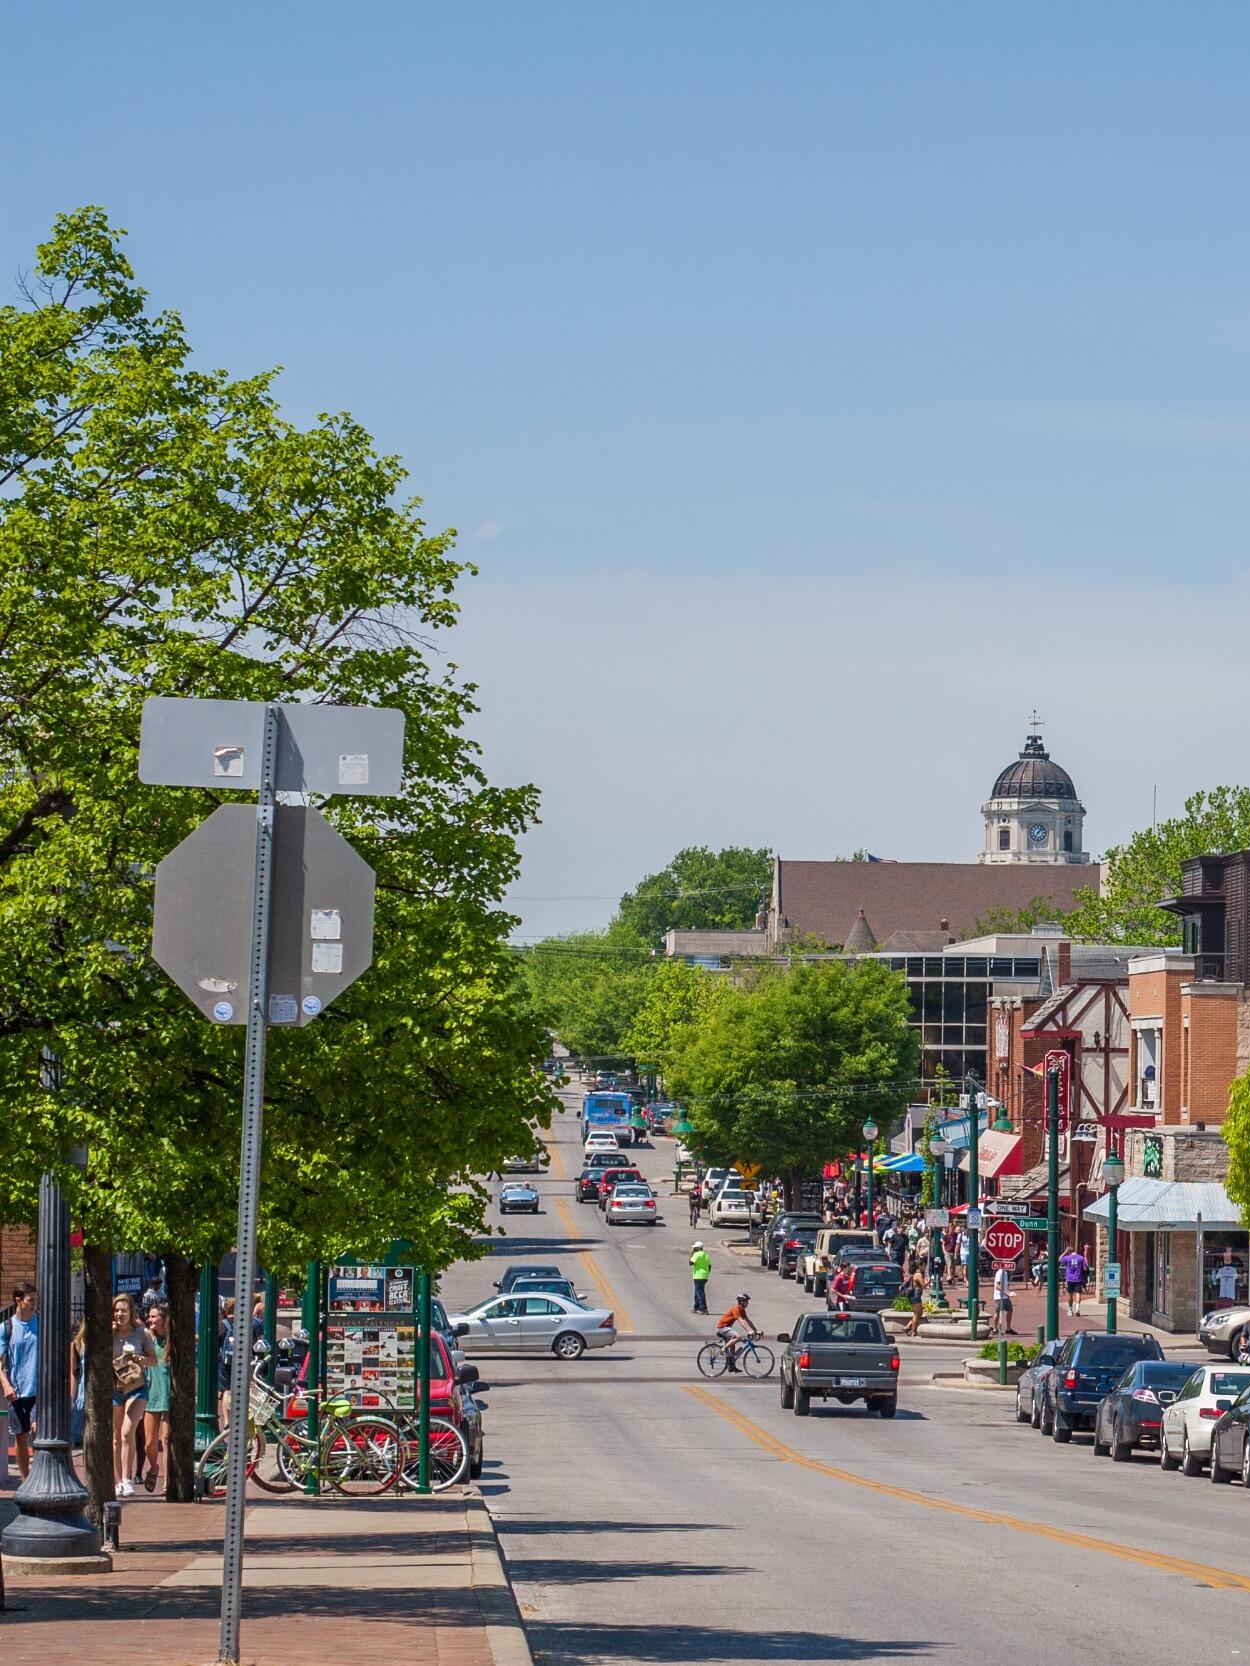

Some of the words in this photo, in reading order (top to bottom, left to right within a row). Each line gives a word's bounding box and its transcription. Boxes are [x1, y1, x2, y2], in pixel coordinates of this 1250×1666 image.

[1020, 1220, 1038, 1228] Dunn
[988, 1233, 1022, 1248] STOP
[117, 1283, 141, 1291] HIRING
[389, 1290, 408, 1300] BEER
